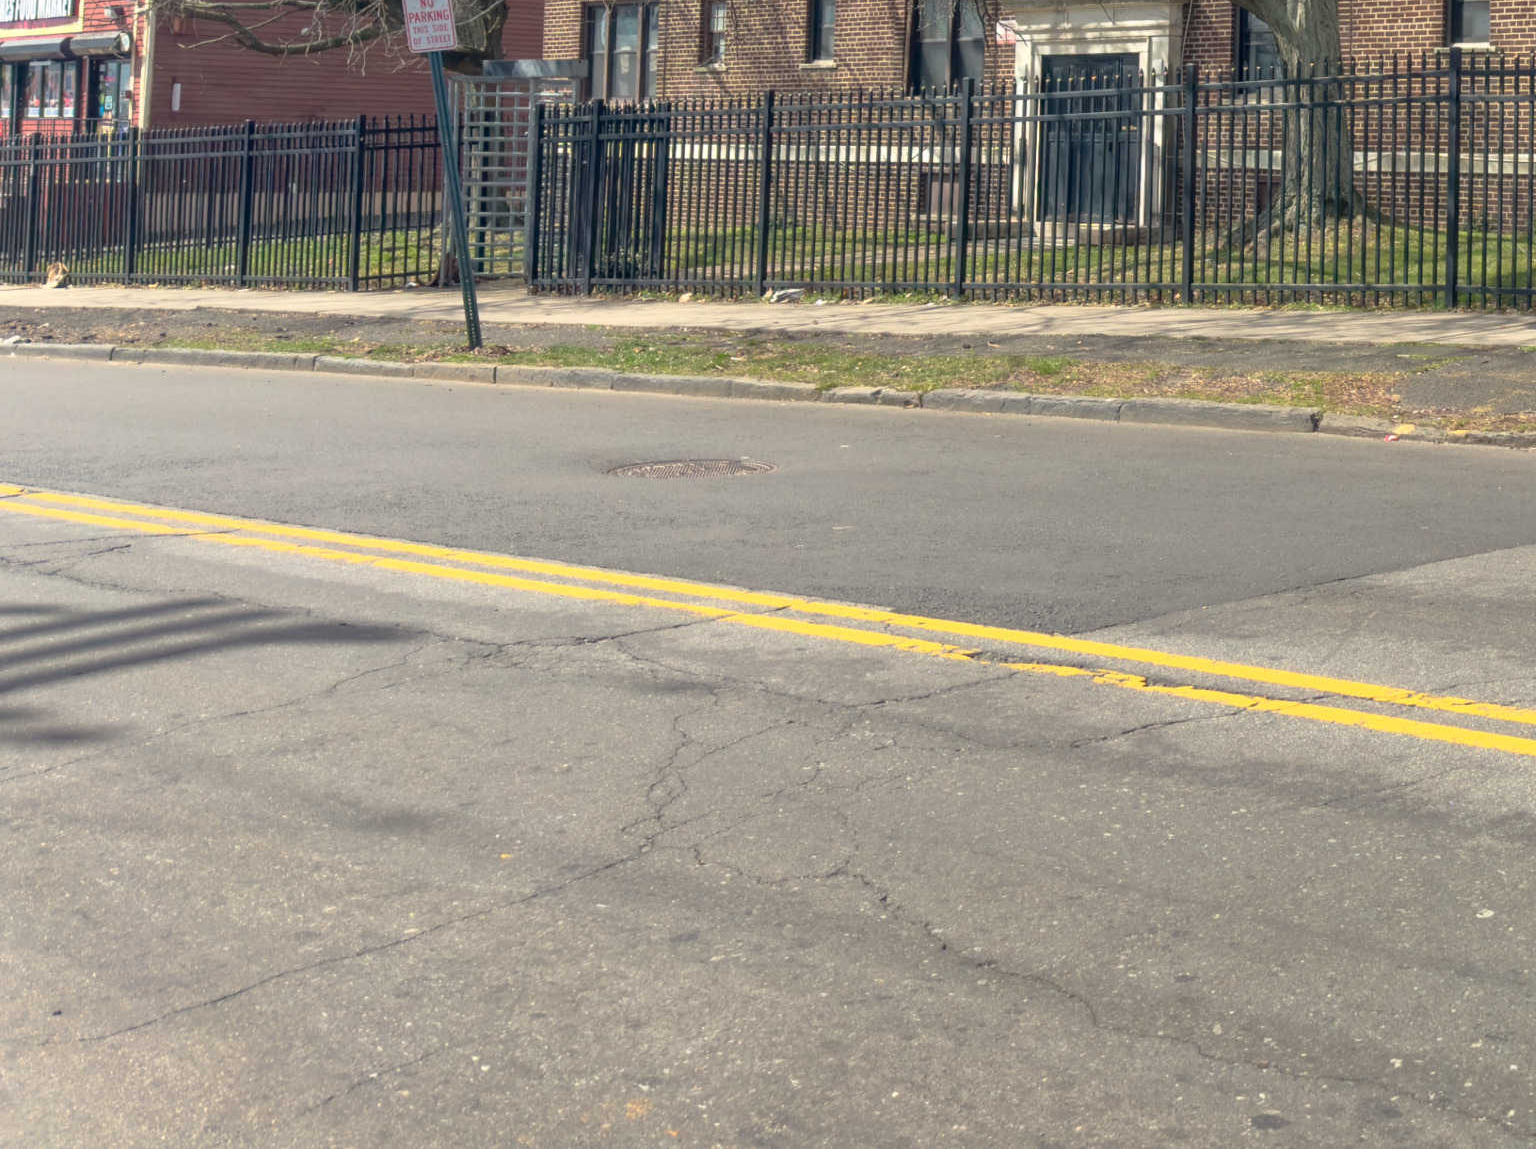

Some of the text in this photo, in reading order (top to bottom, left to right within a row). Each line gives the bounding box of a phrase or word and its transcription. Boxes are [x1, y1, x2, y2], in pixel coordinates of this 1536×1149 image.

[408, 9, 450, 23] PARKING
[412, 23, 449, 35] THIS SIDE
[413, 34, 451, 45] OF STREET
